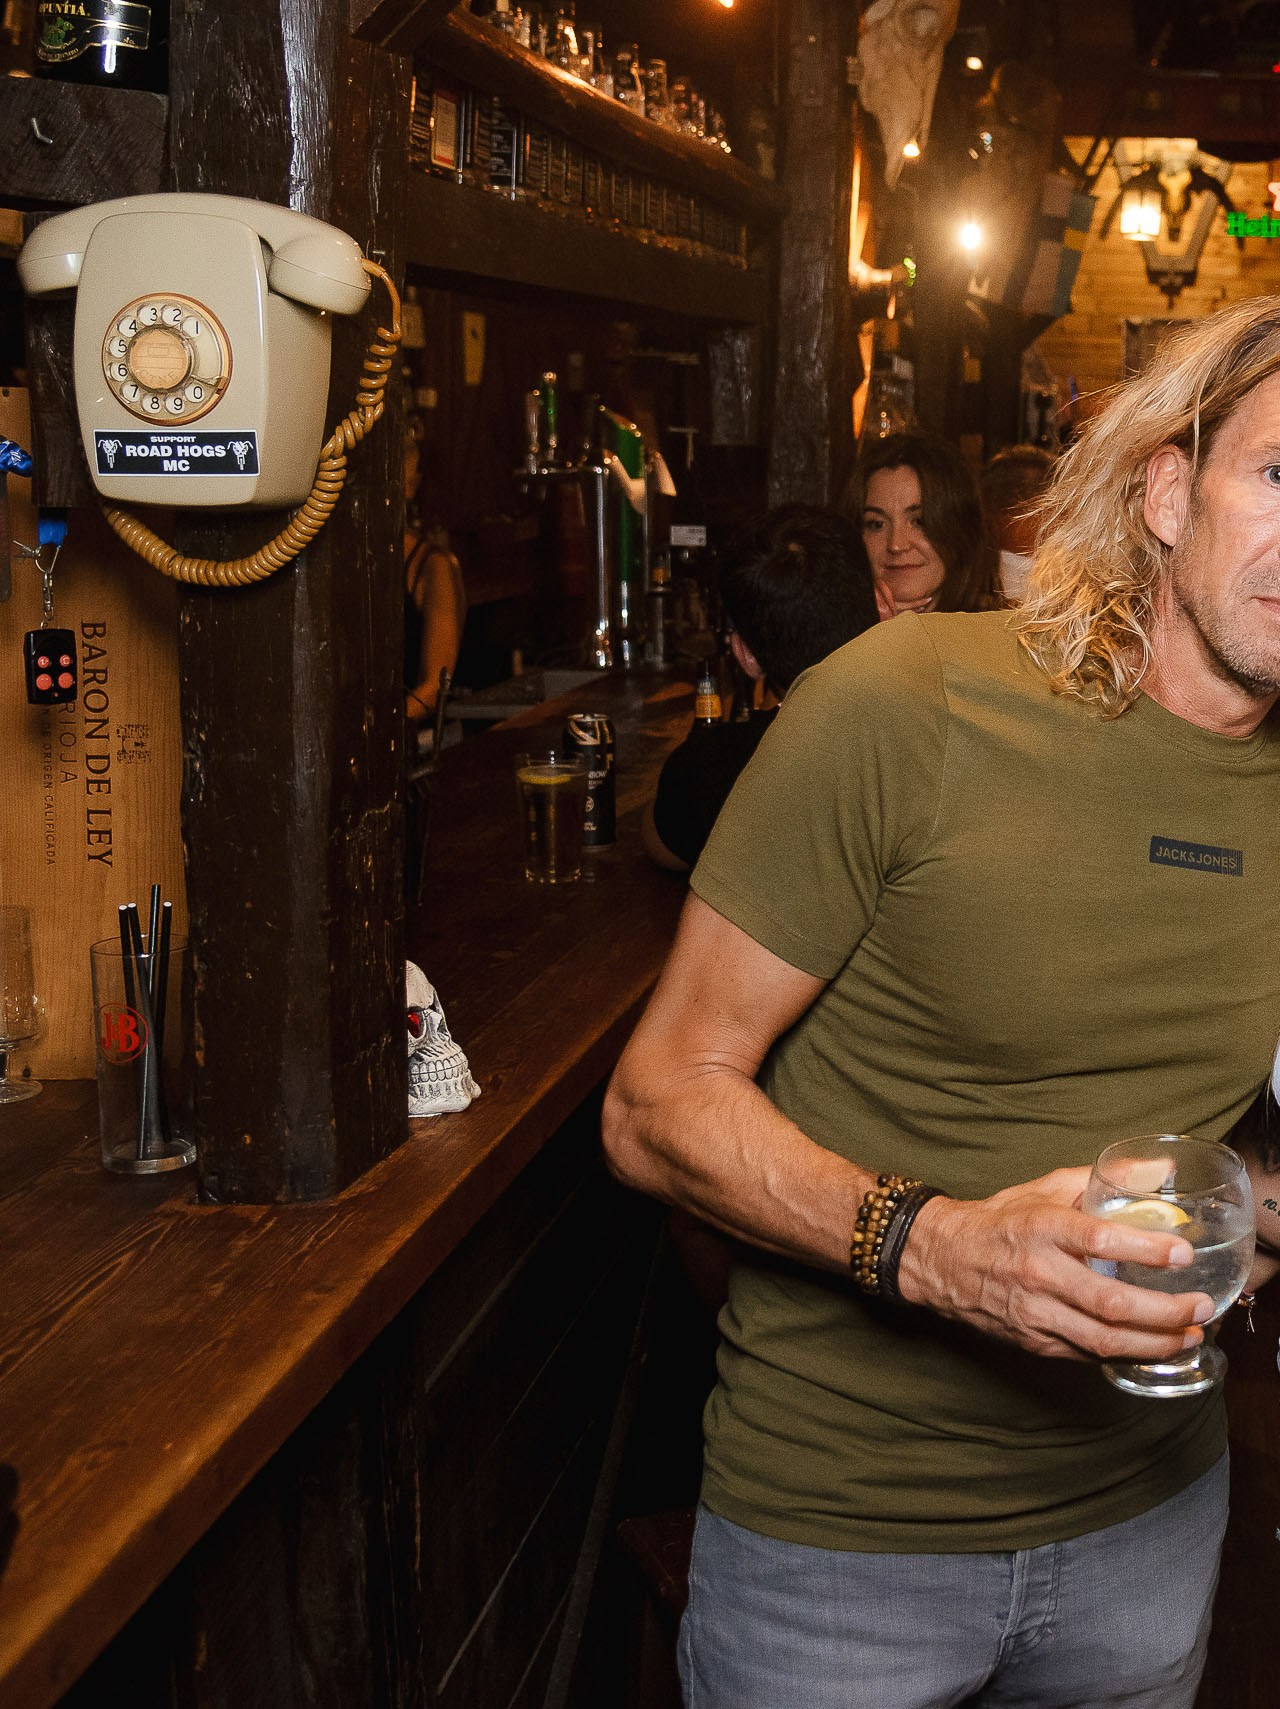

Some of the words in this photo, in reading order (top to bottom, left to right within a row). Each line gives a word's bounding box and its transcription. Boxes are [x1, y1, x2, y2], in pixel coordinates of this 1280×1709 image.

[150, 308, 158, 322] 3
[173, 308, 182, 322] 2
[128, 319, 138, 333] 4
[118, 339, 128, 353] 5
[118, 364, 128, 377] 6
[130, 385, 138, 398] 7
[193, 386, 203, 400] 0
[150, 396, 160, 410] 8
[173, 397, 183, 411] 9
[150, 435, 197, 443] SUPPORT
[125, 445, 174, 457] ROAD
[177, 445, 227, 458] HOGS
[163, 459, 190, 472] MC
[82, 621, 110, 740] BARON
[59, 702, 78, 783] RIOJA
[42, 743, 53, 790] ORIGEN
[85, 753, 112, 794] DE
[43, 795, 56, 865] CALIFICADA
[86, 807, 113, 868] LEY
